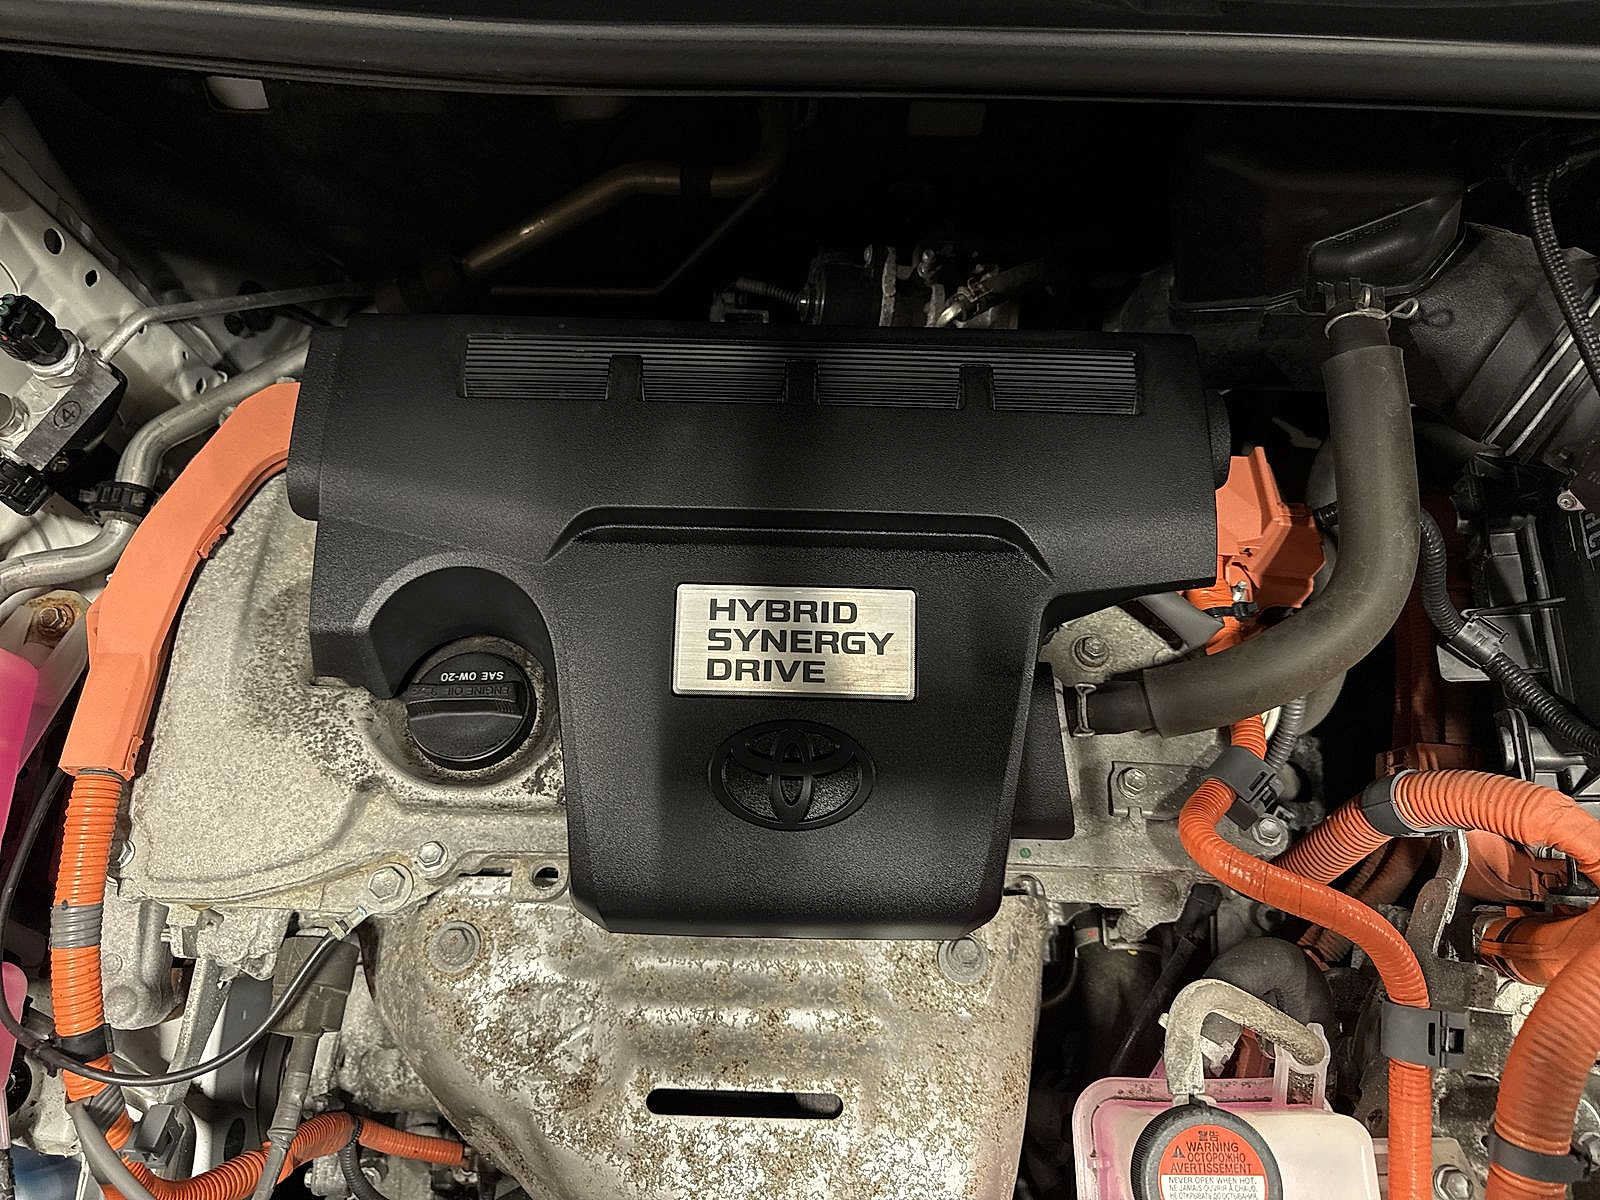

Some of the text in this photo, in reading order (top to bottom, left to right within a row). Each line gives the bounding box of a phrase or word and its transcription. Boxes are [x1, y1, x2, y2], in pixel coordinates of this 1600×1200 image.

[709, 598, 858, 624] HYBRID
[707, 628, 895, 656] SYNERGY
[440, 671, 504, 682] SAE 0W-20
[706, 658, 826, 683] DRIVE
[467, 686, 510, 697] ENGINE
[1186, 1141, 1239, 1153] WARNING
[1187, 1152, 1246, 1163] ОСТОРОЖНО
[1170, 1162, 1252, 1174] AVERTISSEMENT
[1168, 1176, 1194, 1184] NEVER
[1194, 1176, 1215, 1185] OPEN
[1217, 1176, 1238, 1185] WHEN
